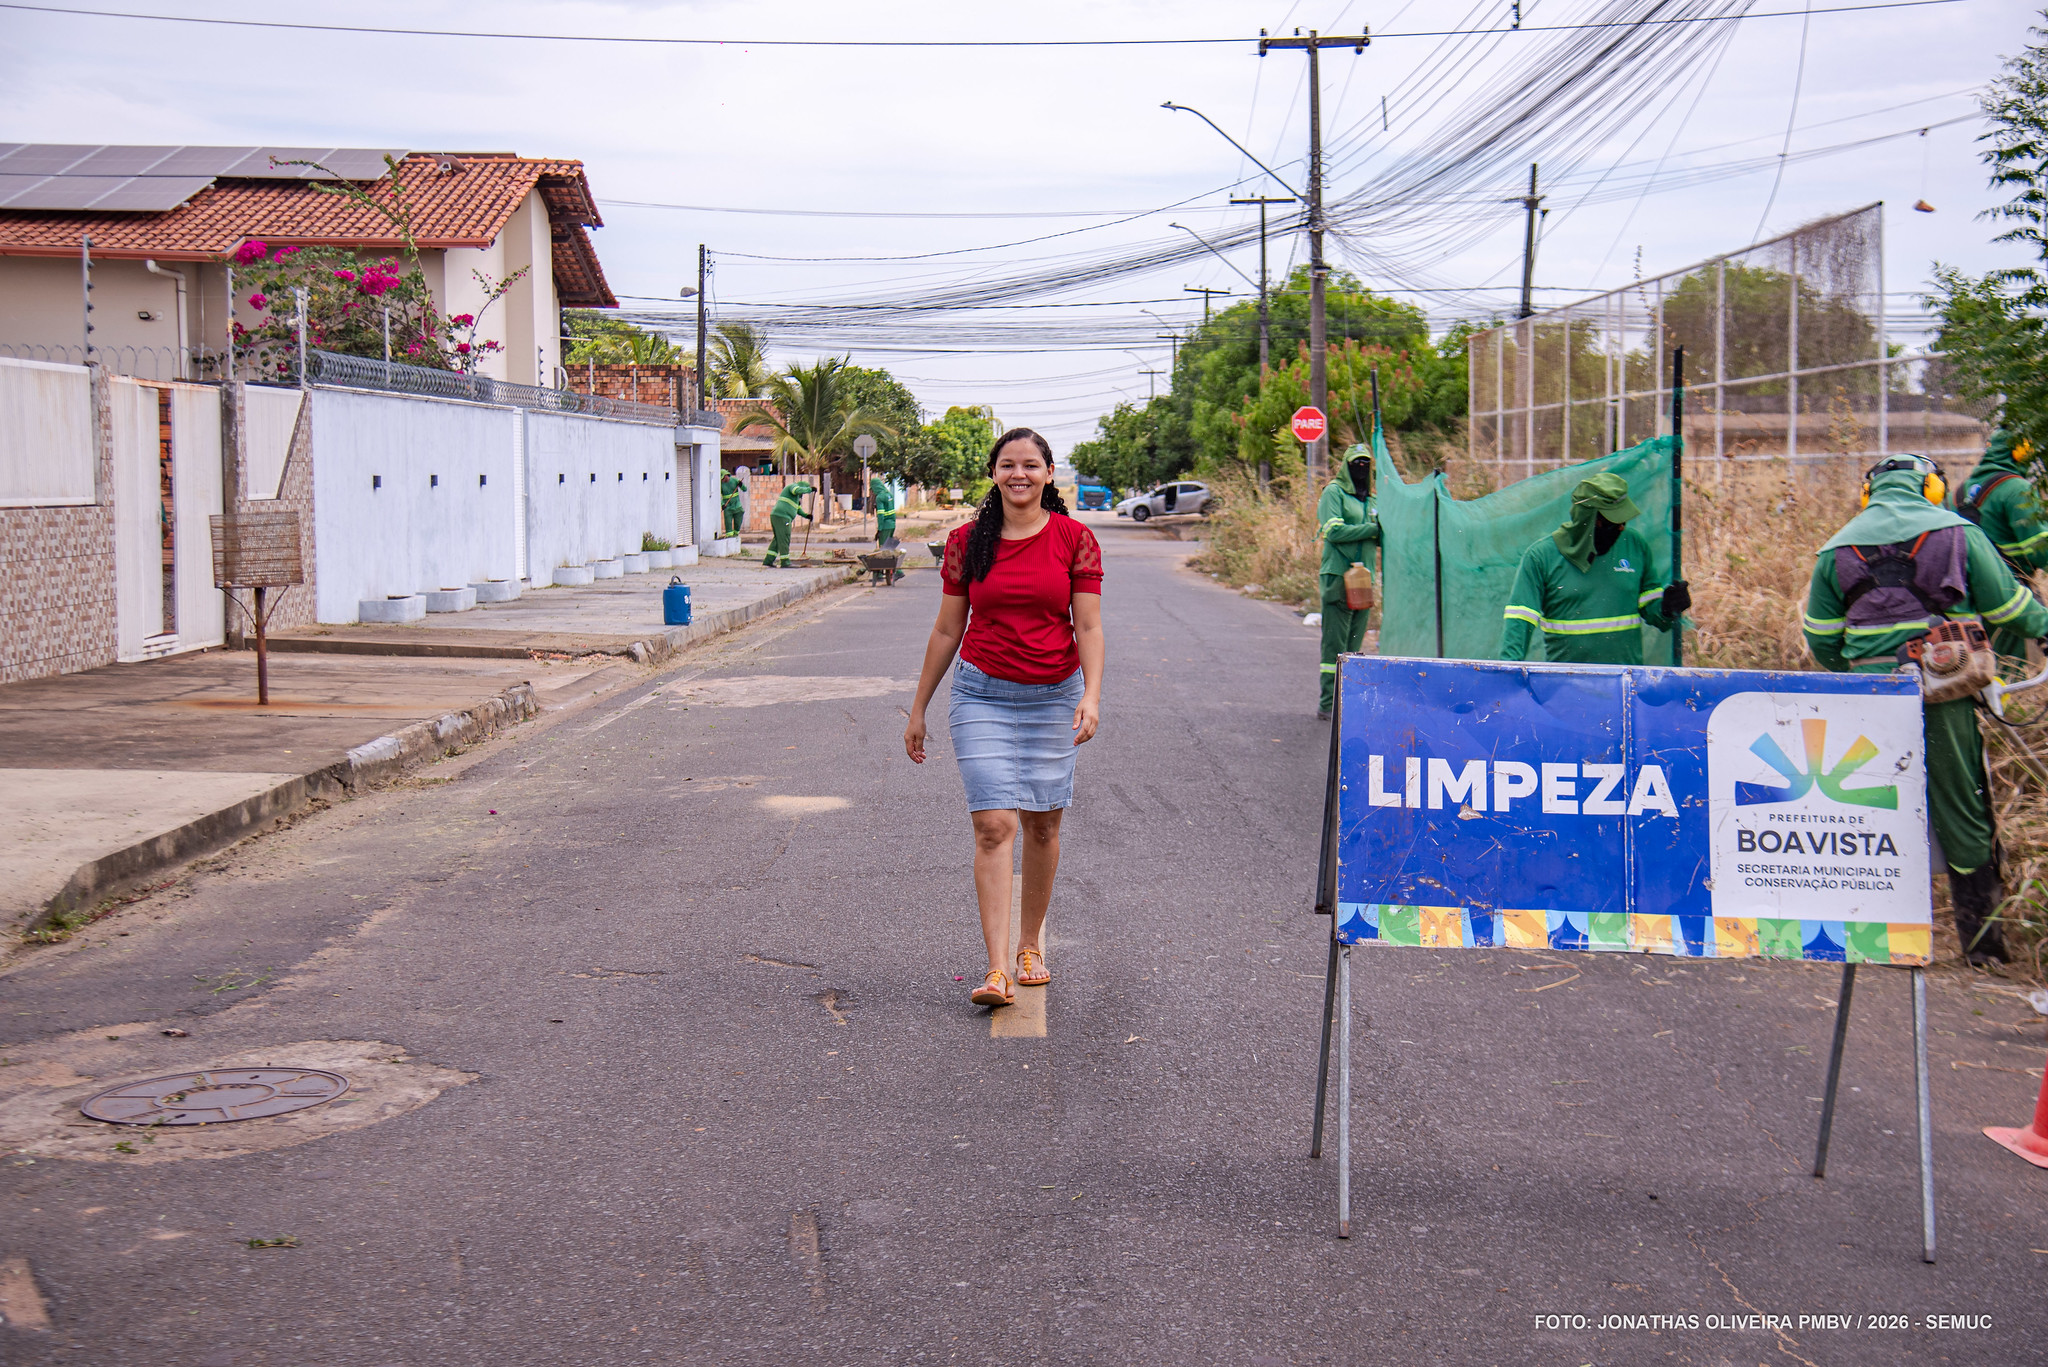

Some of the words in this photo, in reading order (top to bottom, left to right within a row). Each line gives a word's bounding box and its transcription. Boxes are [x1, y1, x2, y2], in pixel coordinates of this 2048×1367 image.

[1294, 418, 1323, 429] PARE
[1368, 754, 1680, 818] LIMPEZA
[1769, 813, 1845, 824] PREFEITURA
[1849, 815, 1865, 825] DE
[1737, 863, 1811, 875] SECRETARIA
[1813, 865, 1880, 877] MUNICIPAL
[1884, 867, 1901, 878] DE
[1744, 877, 1838, 891] CONSERVAÇÃO
[1841, 878, 1894, 891] PÚBLICA
